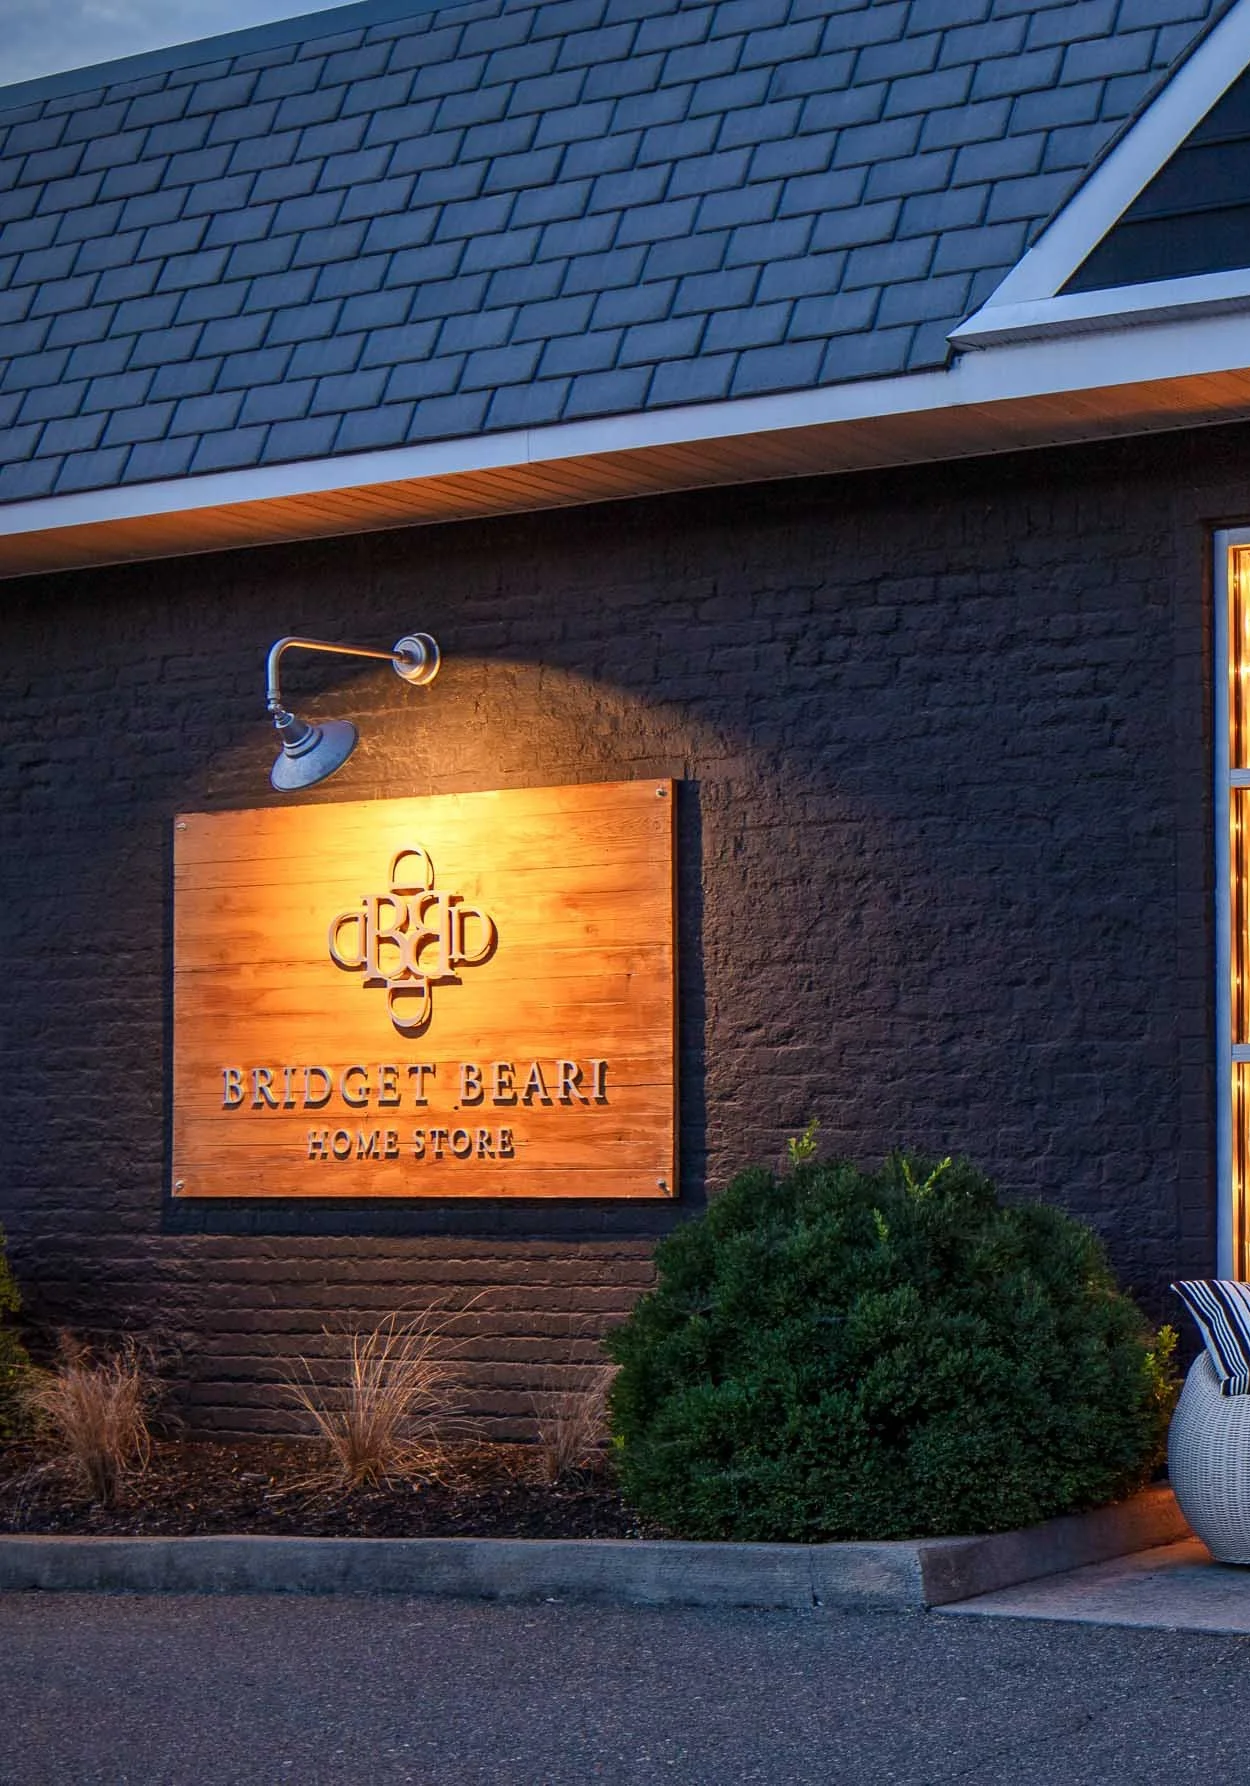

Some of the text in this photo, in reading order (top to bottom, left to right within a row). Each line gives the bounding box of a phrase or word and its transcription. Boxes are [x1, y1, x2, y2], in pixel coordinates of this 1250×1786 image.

[222, 1060, 609, 1109] BRIDGET BEARI
[307, 1127, 515, 1160] HOME STORE
